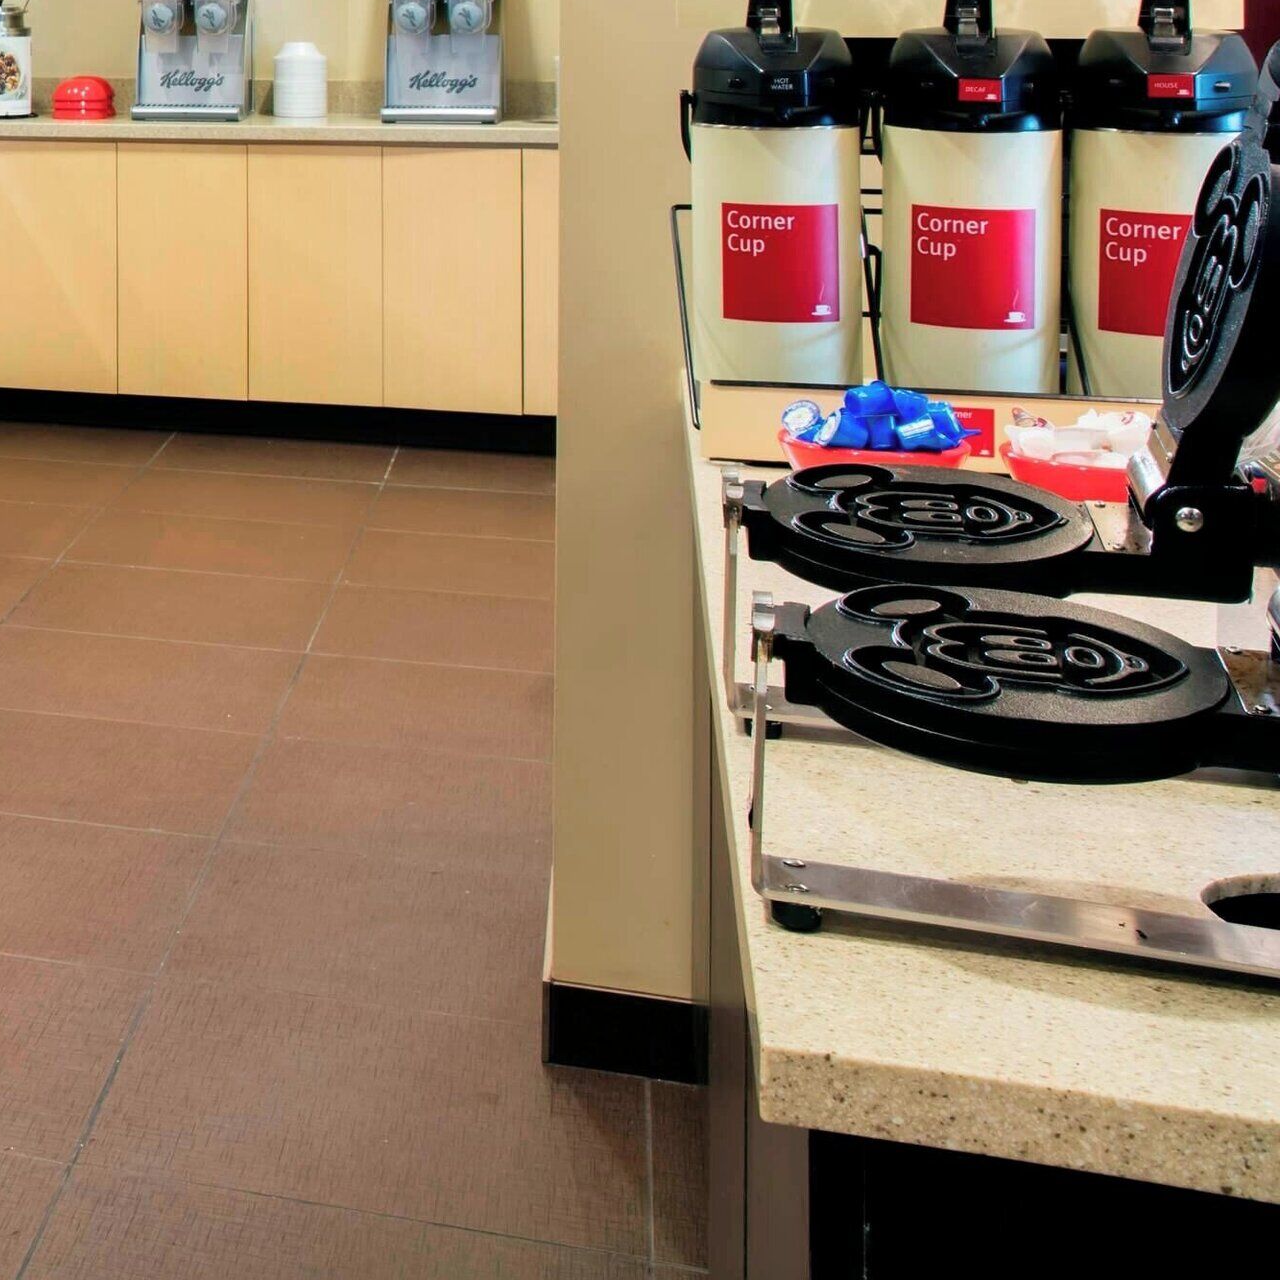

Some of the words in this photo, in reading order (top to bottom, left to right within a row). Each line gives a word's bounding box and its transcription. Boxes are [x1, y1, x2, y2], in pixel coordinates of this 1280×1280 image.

[159, 68, 225, 93] Kellogg's
[408, 69, 478, 94] Kellogg's
[773, 77, 790, 85] HOT
[1154, 81, 1179, 89] HOUSE
[726, 210, 796, 231] Corner
[916, 212, 989, 235] Corner
[1105, 217, 1182, 240] Corner
[727, 233, 766, 257] Cup
[916, 236, 957, 261] Cup
[1105, 241, 1148, 267] Cup
[952, 410, 973, 419] rner
